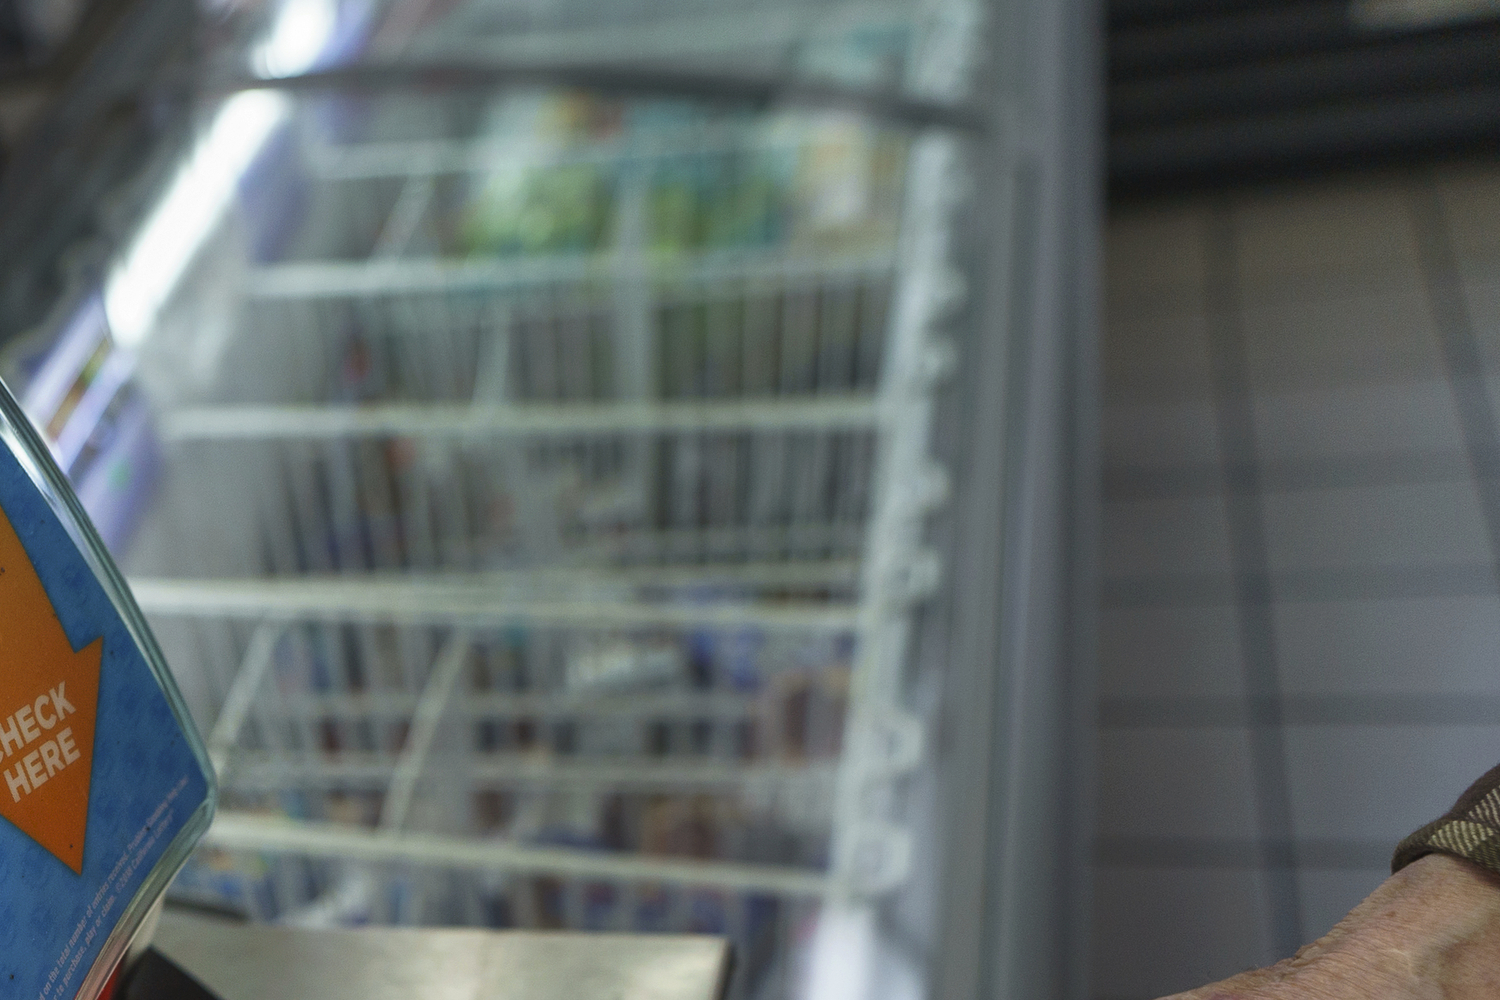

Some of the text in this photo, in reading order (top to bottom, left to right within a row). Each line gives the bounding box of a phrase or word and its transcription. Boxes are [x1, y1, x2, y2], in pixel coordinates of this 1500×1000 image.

[2, 726, 81, 803] HERE
[42, 981, 52, 995] on
[47, 966, 60, 982] the
[55, 944, 71, 967] total
[68, 915, 89, 948] number
[84, 904, 95, 917] of
[90, 881, 110, 908] entries
[54, 984, 65, 995] to
[83, 925, 98, 945] play
[93, 915, 103, 927] or
